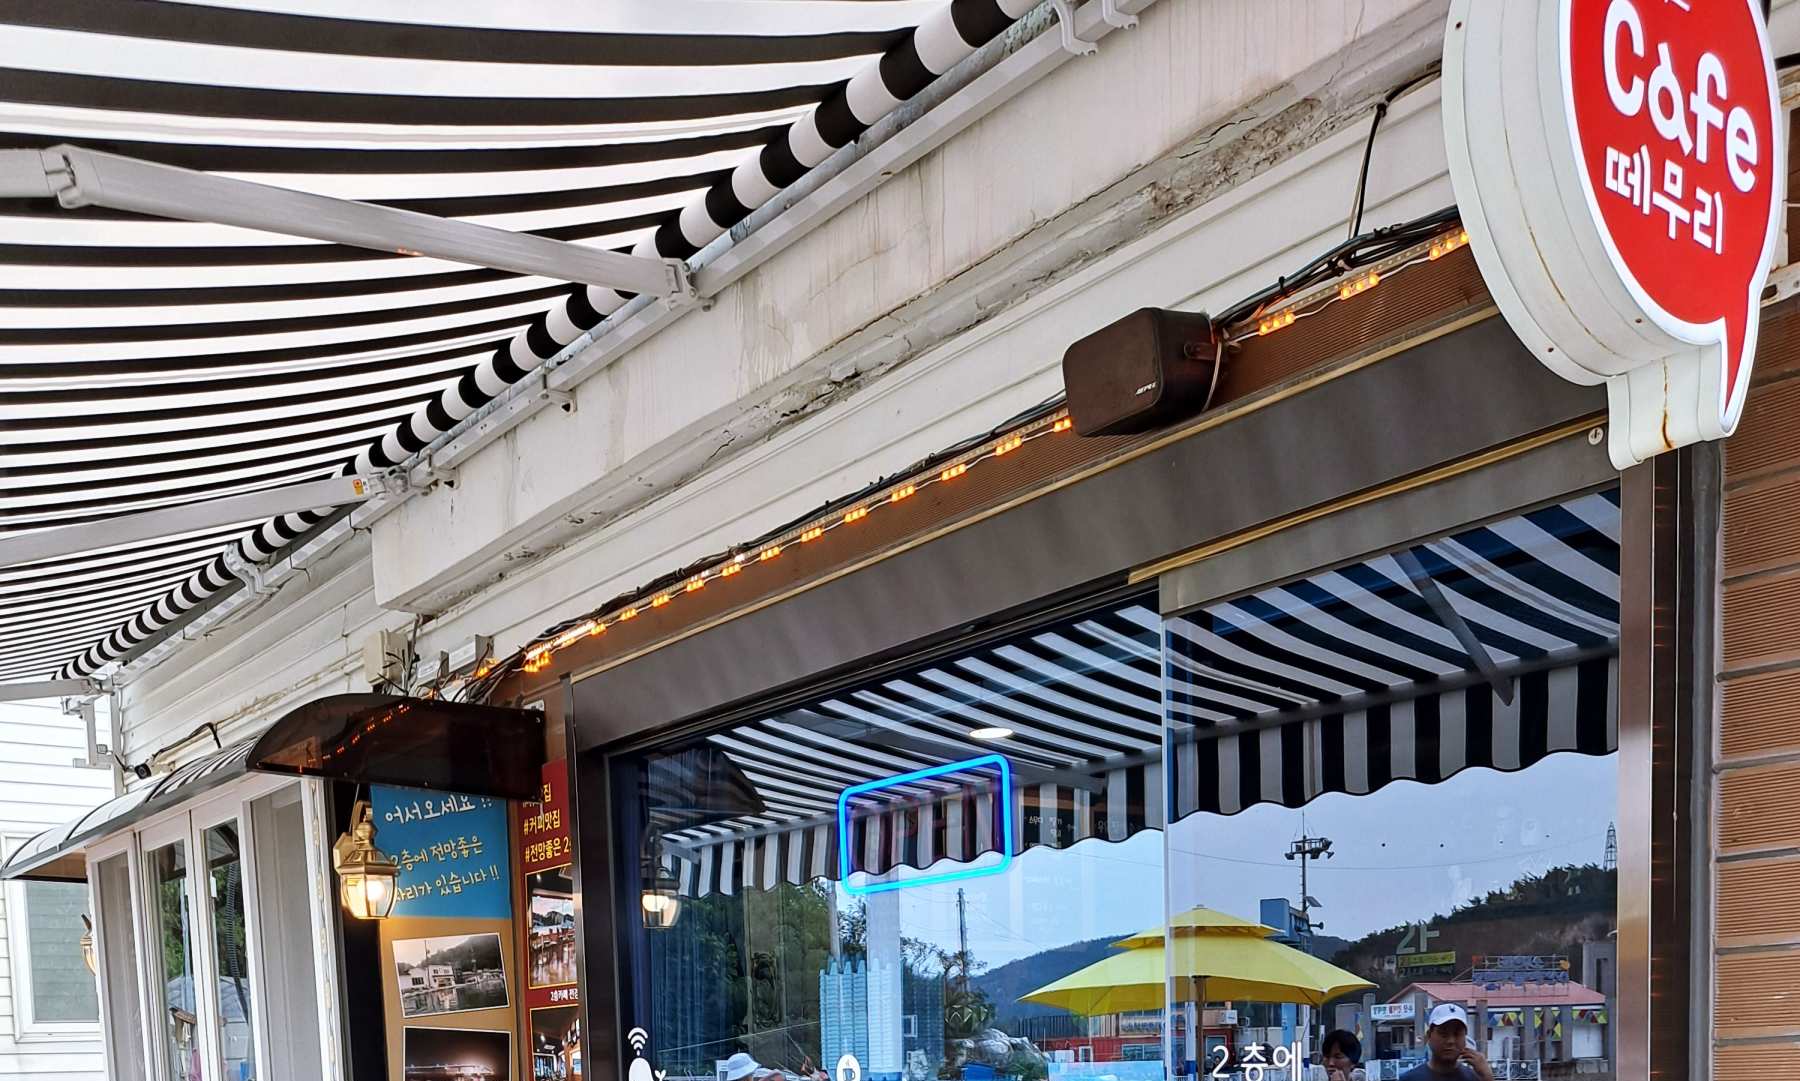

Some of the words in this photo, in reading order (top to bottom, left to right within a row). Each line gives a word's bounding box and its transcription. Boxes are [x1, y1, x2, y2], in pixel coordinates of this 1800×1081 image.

[1603, 0, 1758, 192] Cafe
[1605, 144, 1723, 254] 떼무리
[385, 794, 476, 824] 어서오세요
[430, 836, 482, 861] 전망좋은
[525, 837, 562, 863] #전망좋은
[435, 872, 487, 896] 있습니다
